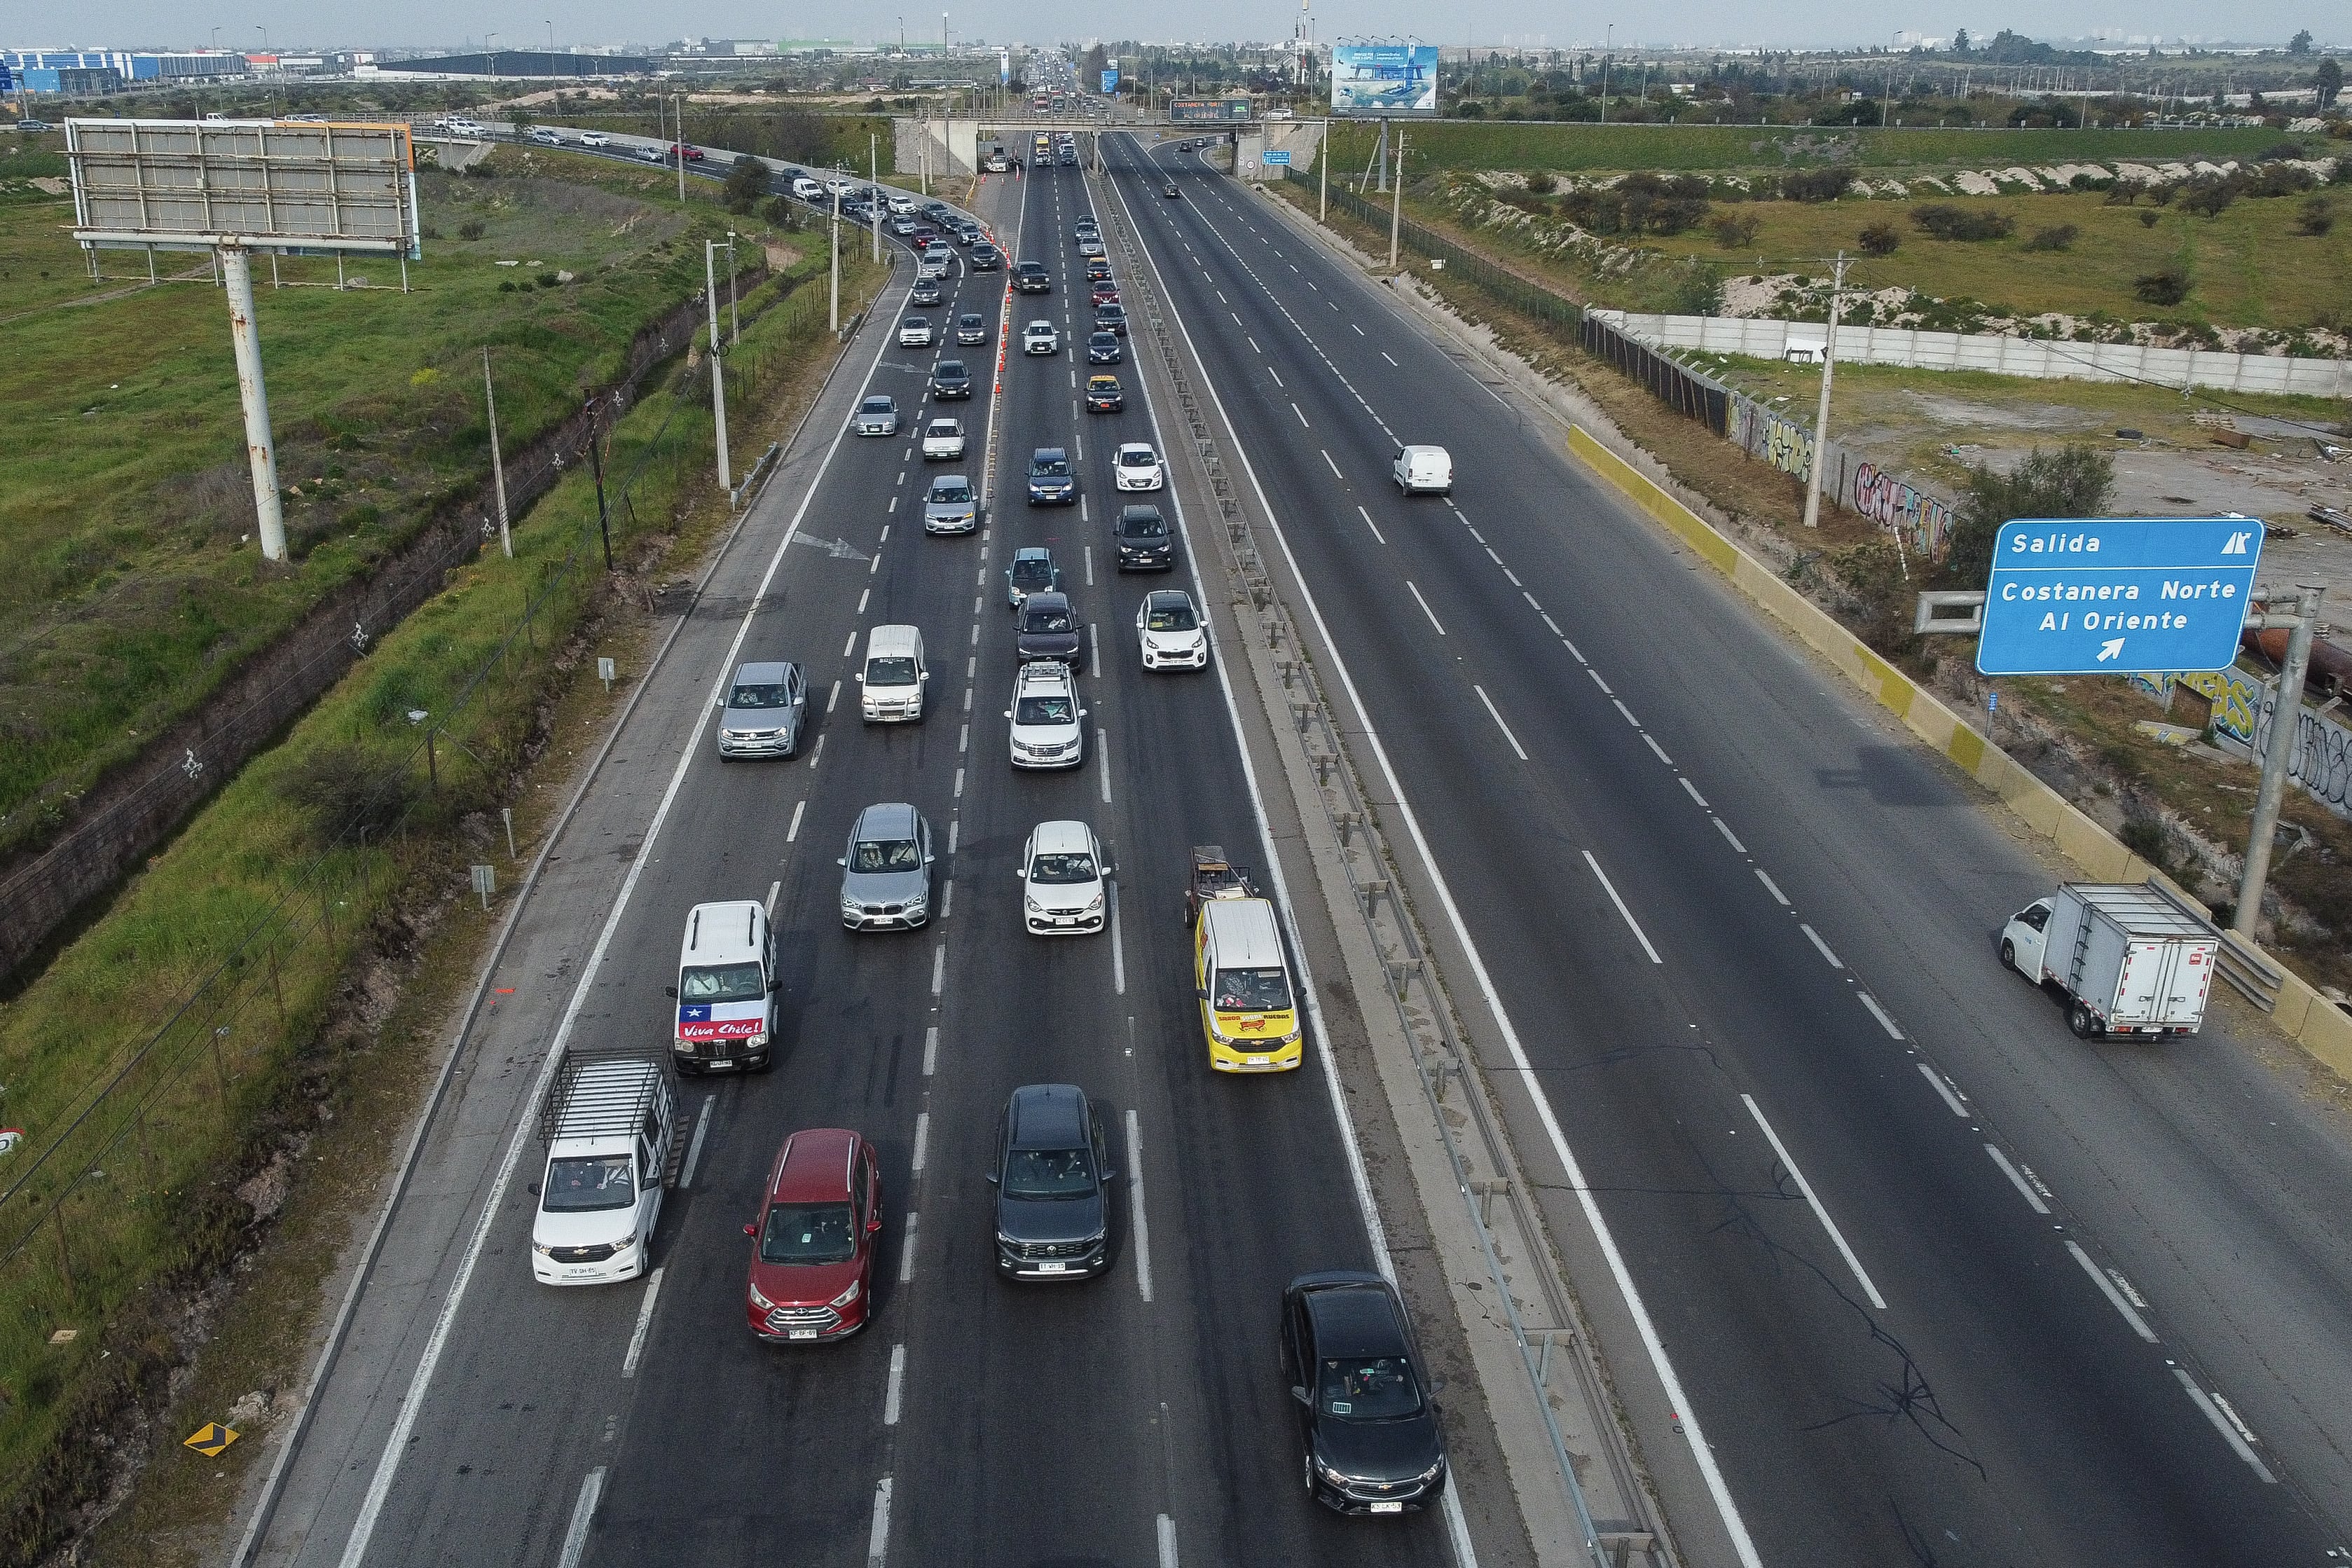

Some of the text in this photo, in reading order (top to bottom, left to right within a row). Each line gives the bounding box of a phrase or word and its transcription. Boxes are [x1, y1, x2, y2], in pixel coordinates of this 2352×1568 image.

[2011, 533, 2100, 553] Salida
[2002, 580, 2236, 601] Costanera Norte
[2038, 611, 2188, 631] Al Oriente
[684, 1022, 759, 1036] Viva Chile!
